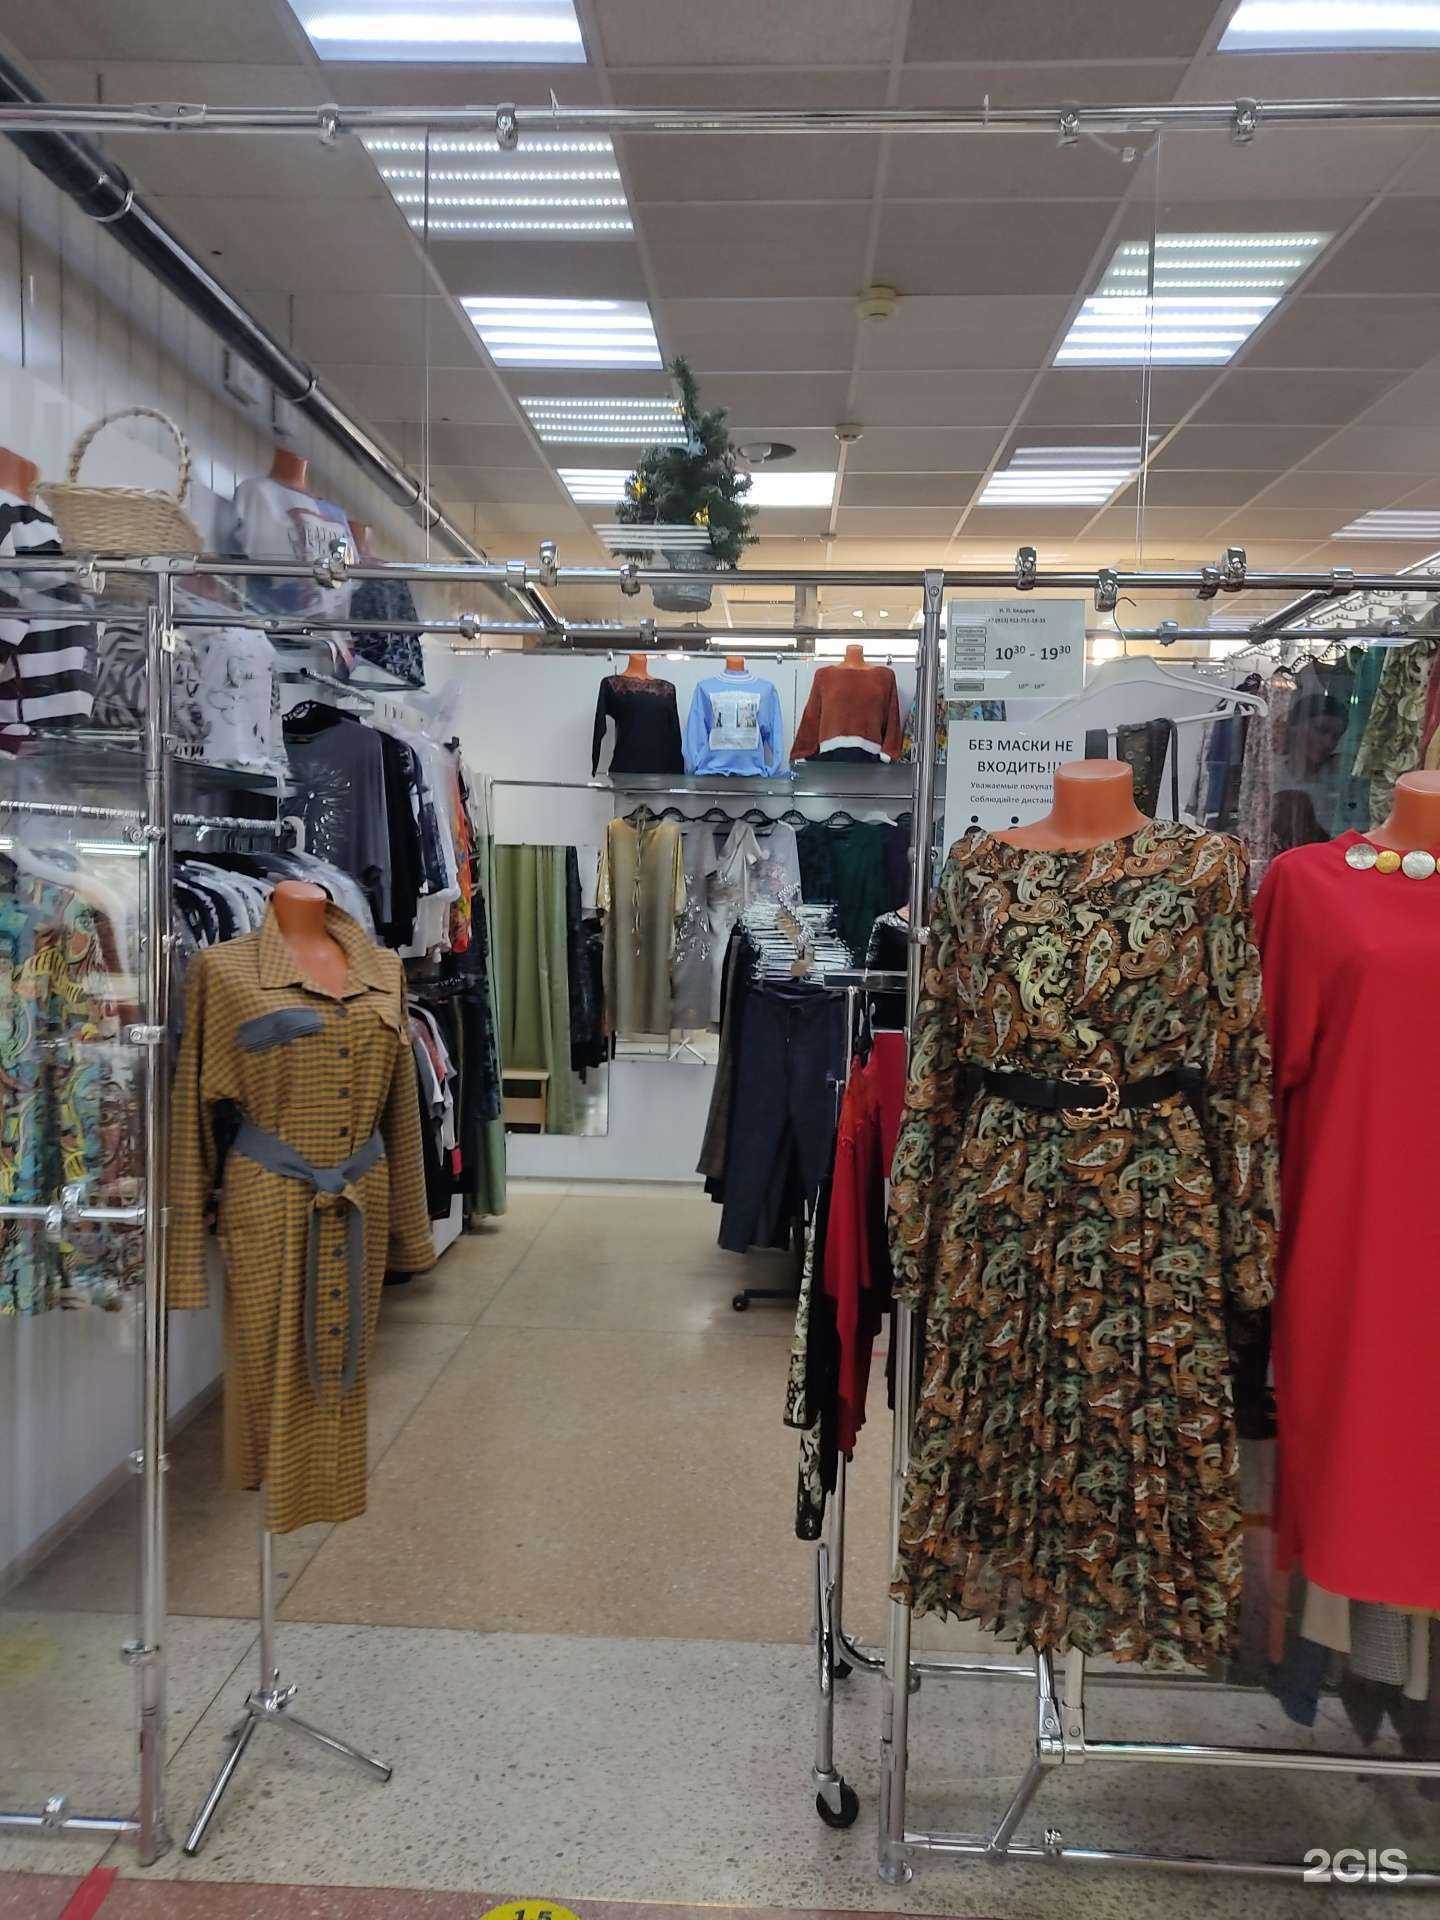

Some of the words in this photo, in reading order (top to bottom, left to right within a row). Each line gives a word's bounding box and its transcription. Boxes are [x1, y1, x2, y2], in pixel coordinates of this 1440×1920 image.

[968, 739, 993, 751] БЕЗ
[997, 740, 1050, 751] МАСКИ
[1055, 740, 1074, 752] НЕ
[970, 781, 1019, 791] Уважаемые
[1020, 784, 1053, 793] покупат
[970, 795, 1020, 805] Соблюдайте
[1021, 797, 1054, 805] дистанц
